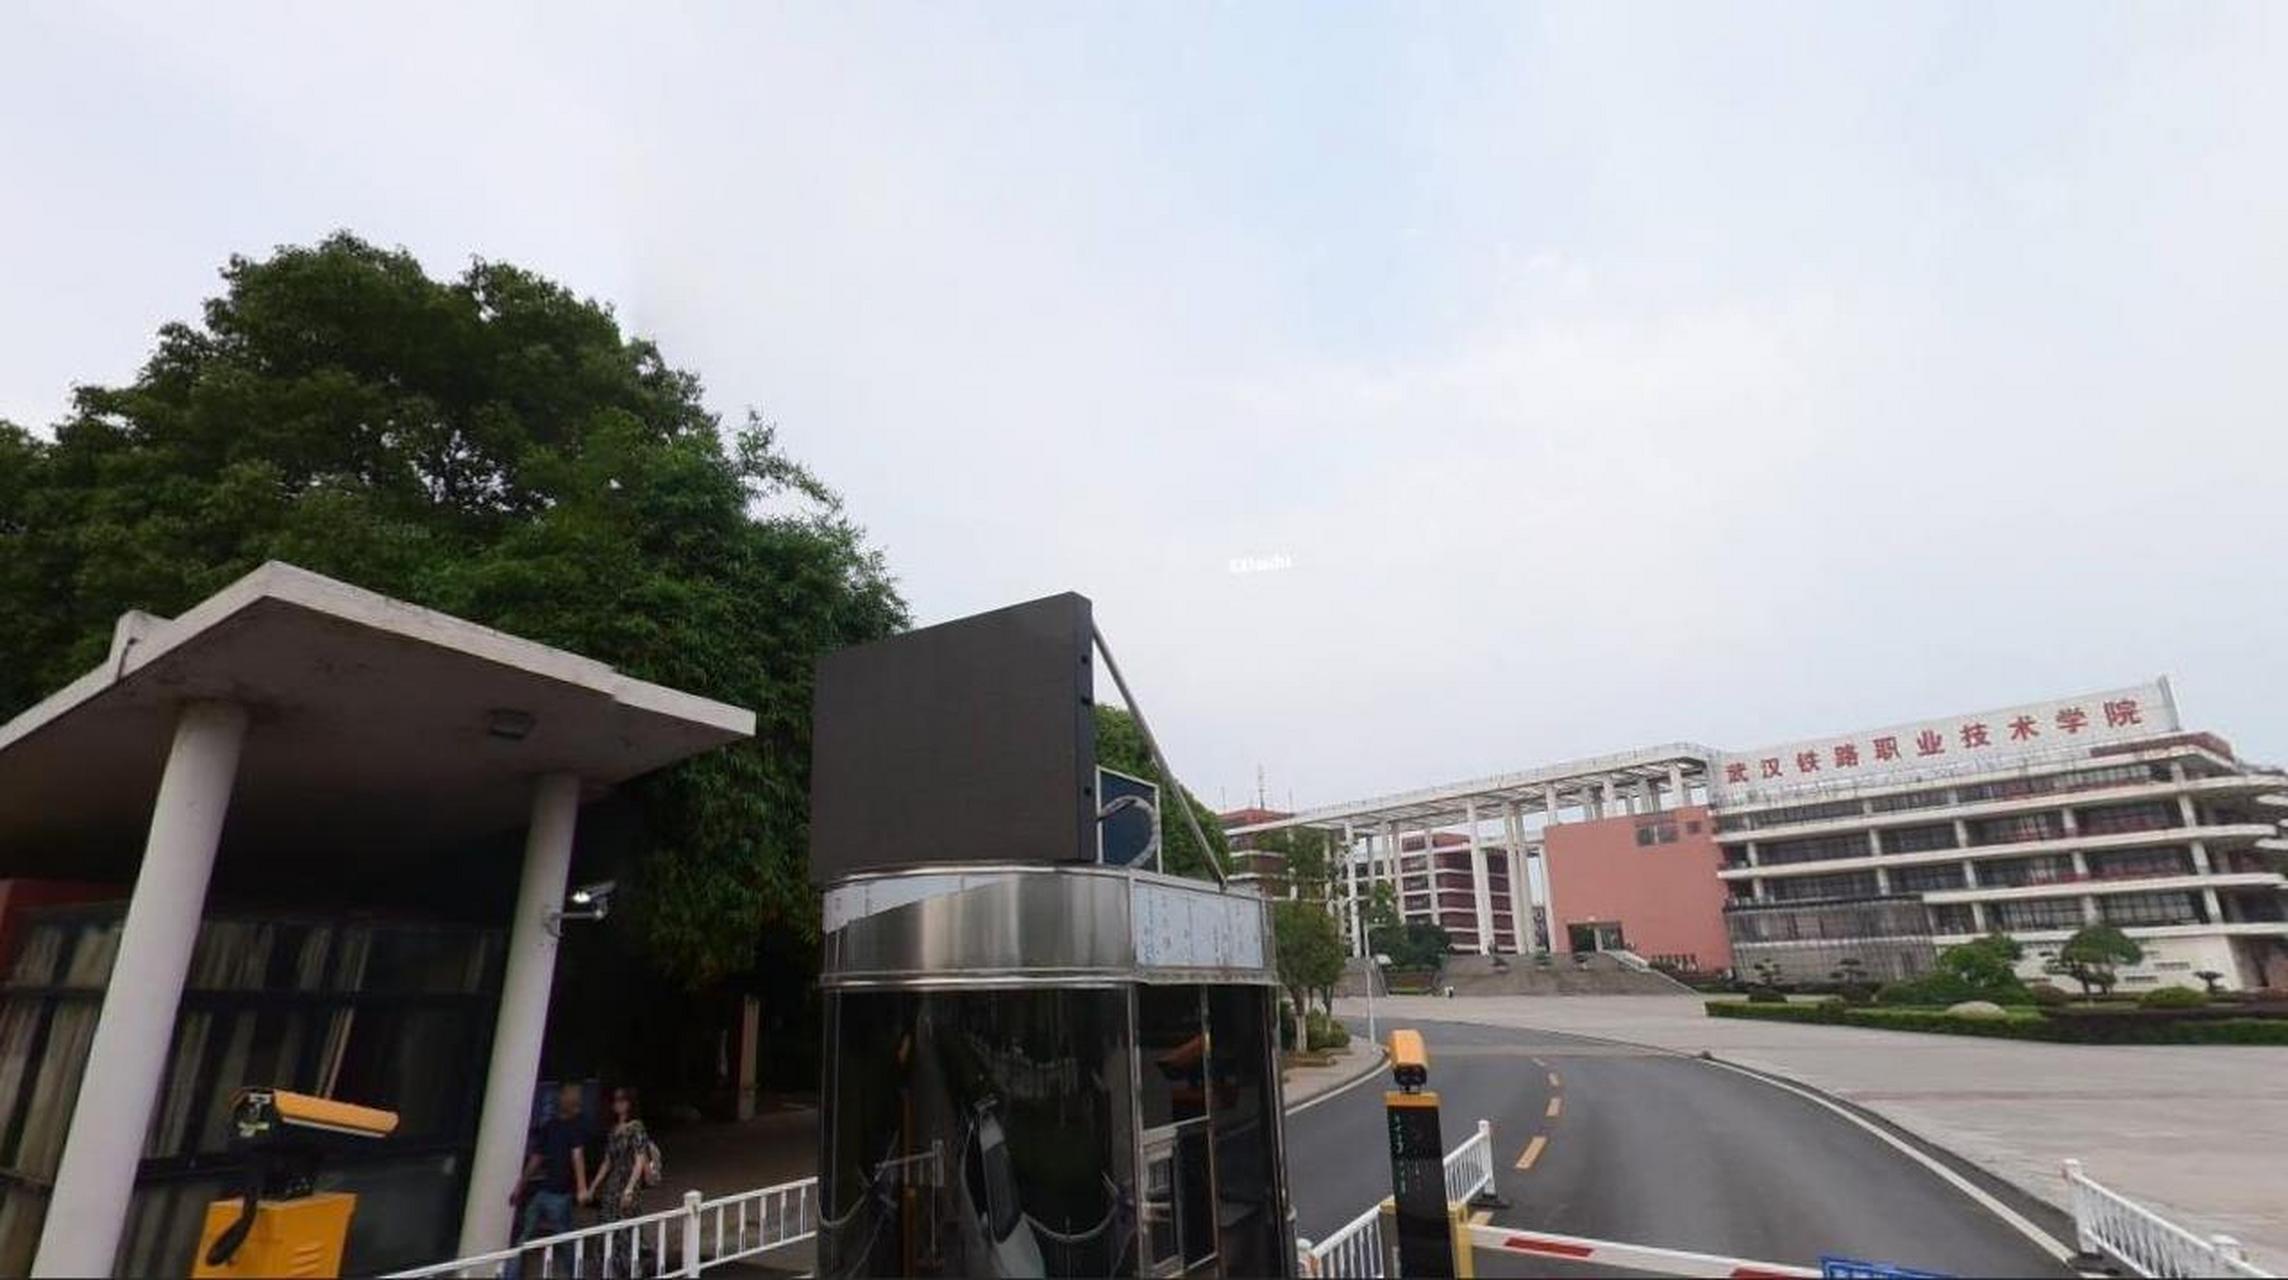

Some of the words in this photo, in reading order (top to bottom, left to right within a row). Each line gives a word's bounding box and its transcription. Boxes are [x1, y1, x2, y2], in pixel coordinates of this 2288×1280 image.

[1725, 698, 2143, 783] 武汉铁路职业技术学院
